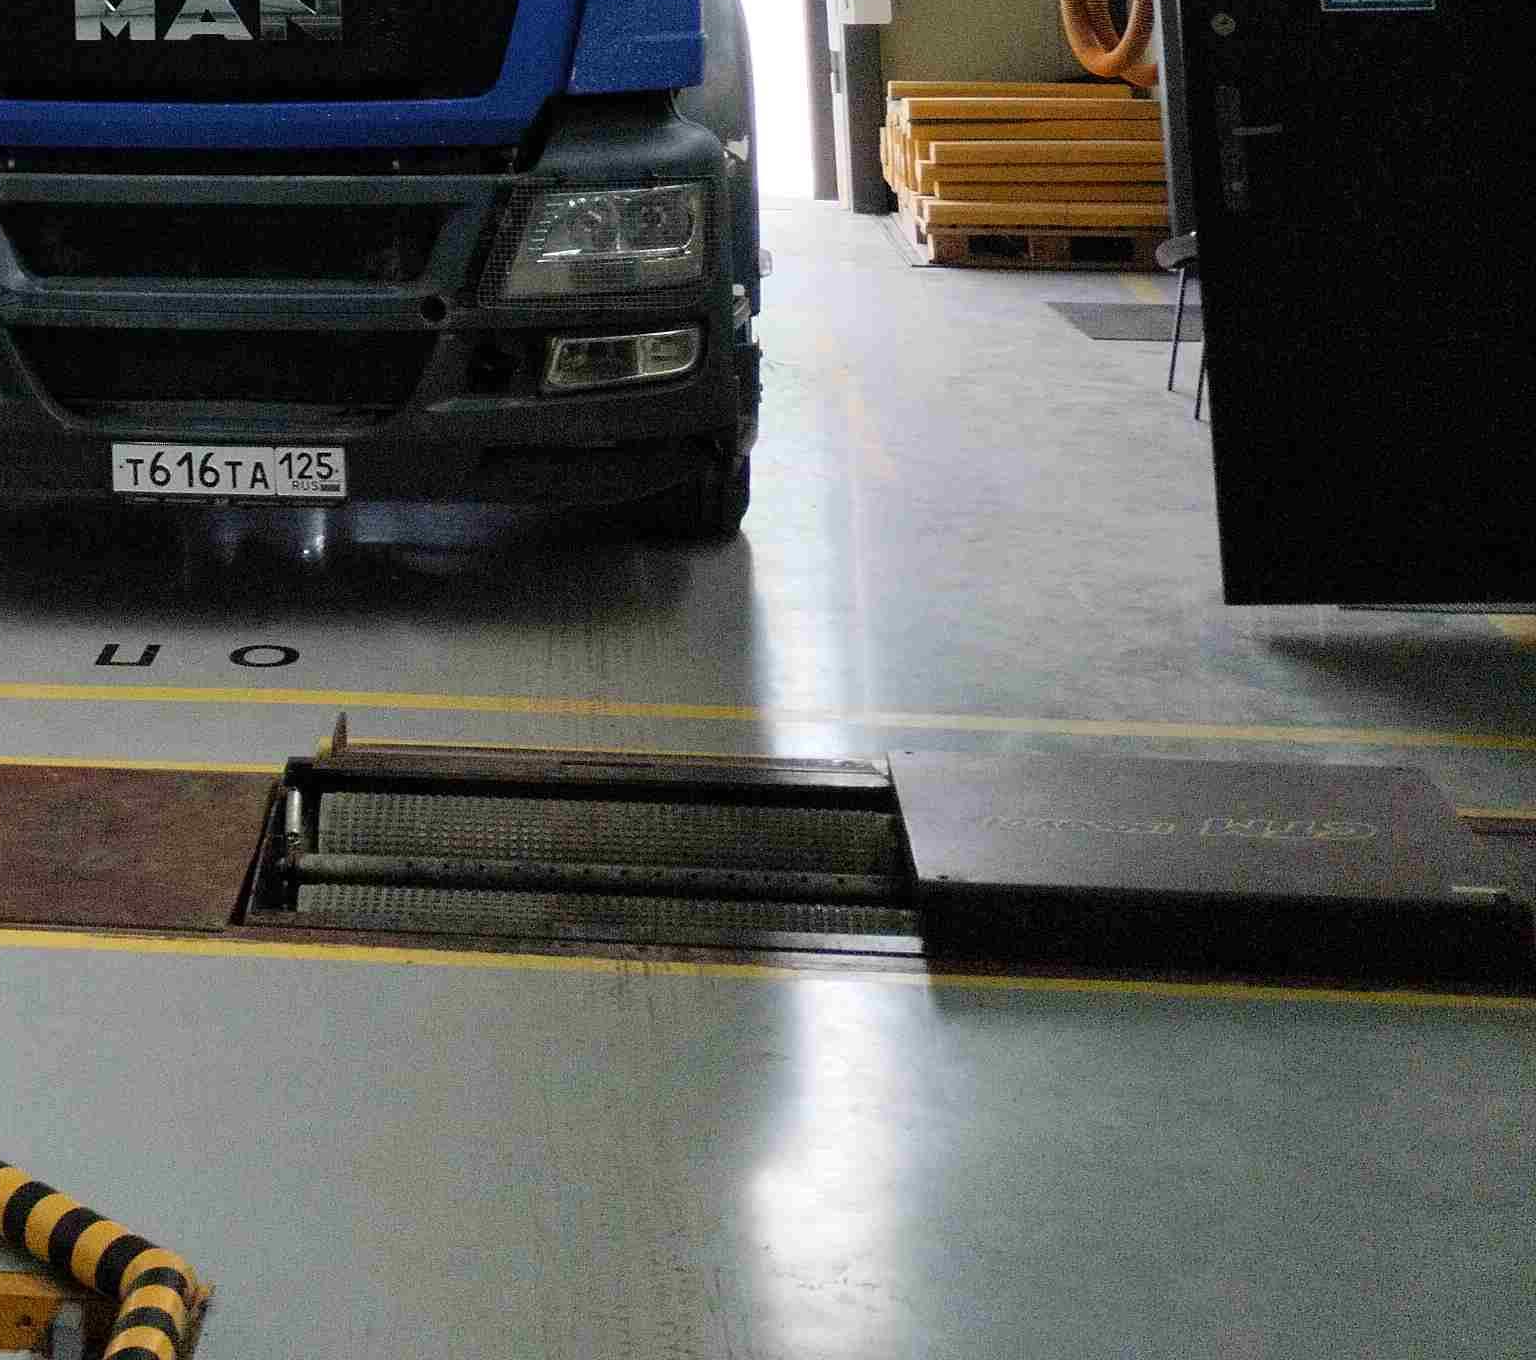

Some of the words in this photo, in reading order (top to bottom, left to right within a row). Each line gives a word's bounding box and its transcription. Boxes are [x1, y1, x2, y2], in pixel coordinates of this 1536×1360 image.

[125, 451, 270, 490] Т616ТА
[279, 452, 334, 480] 125
[292, 481, 319, 492] RUS
